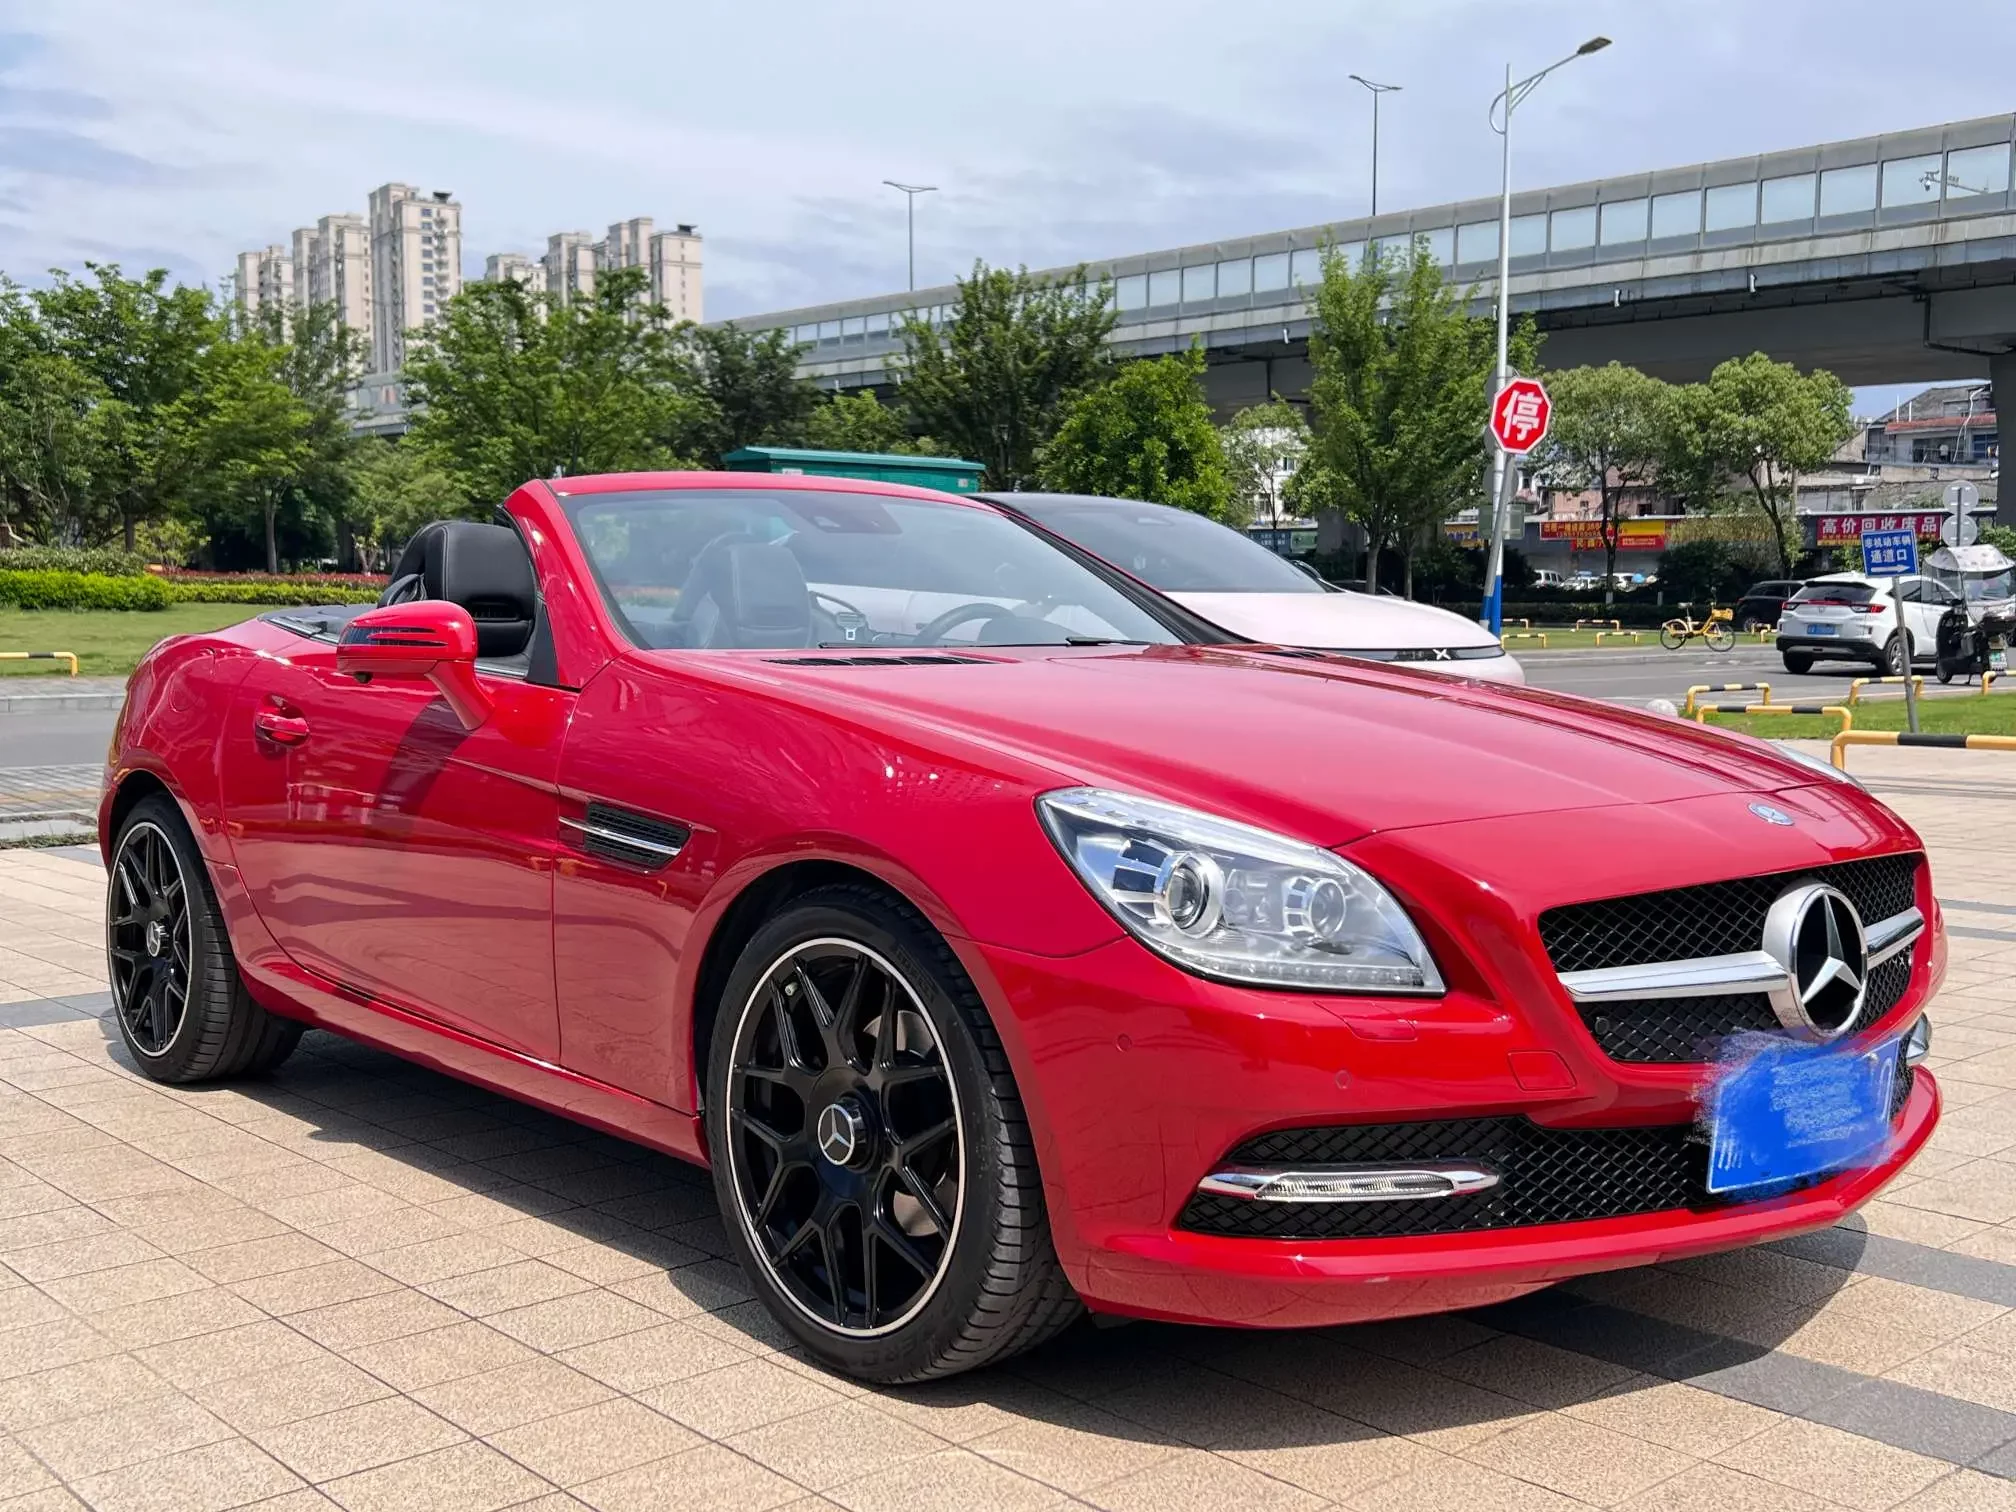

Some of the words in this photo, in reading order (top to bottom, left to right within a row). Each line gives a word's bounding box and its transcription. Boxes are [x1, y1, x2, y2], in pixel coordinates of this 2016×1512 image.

[1502, 390, 1543, 441] 停
[1822, 516, 1937, 534] 高价回收废品
[1865, 535, 1911, 548] 非机动车辆
[1871, 549, 1907, 563] 通道口
